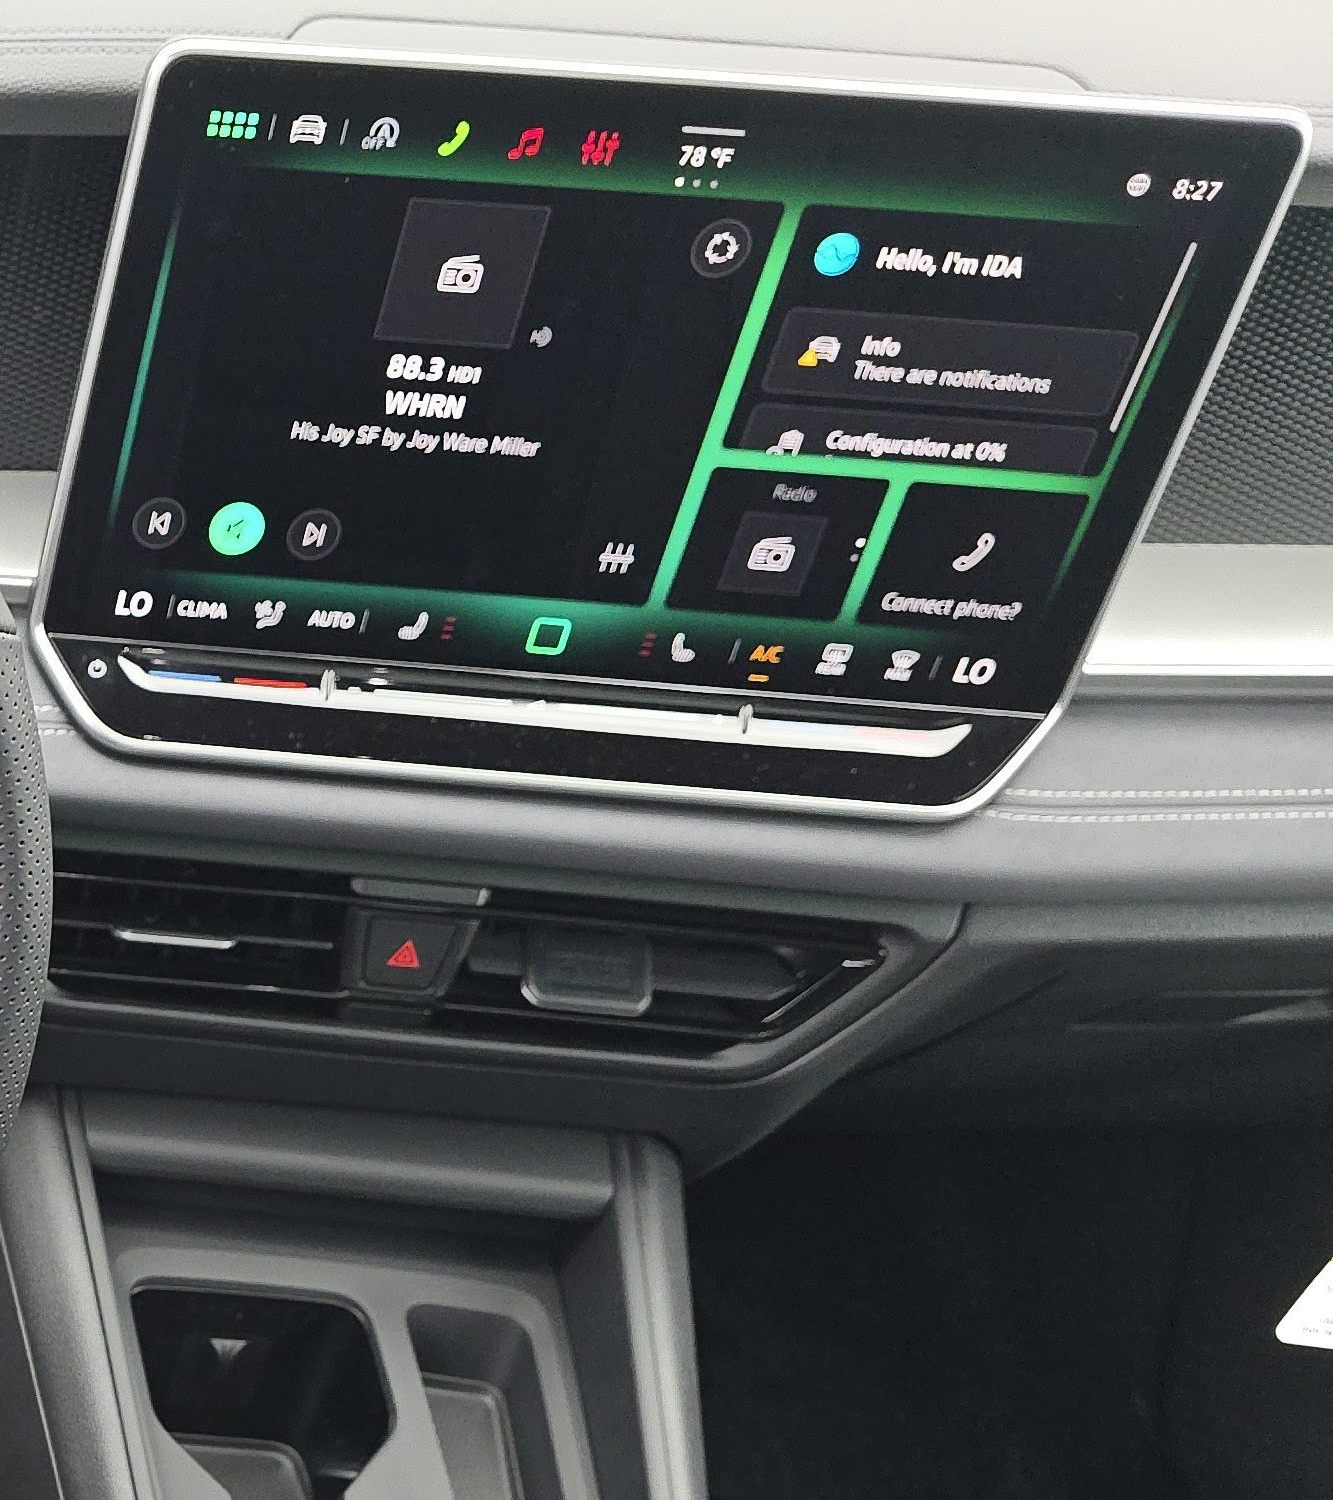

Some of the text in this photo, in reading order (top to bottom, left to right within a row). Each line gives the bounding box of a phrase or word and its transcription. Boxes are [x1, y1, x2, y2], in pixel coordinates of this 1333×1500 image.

[678, 145, 707, 167] 78
[1172, 179, 1224, 202] 8:27
[876, 247, 1023, 280] Hello, I'm IDA
[861, 335, 901, 357] Info
[386, 353, 482, 384] 88.3 HD1
[854, 360, 1052, 394] There are notifications
[385, 389, 466, 420] WHRN
[290, 421, 541, 458] His Joy SF by Joy Ware Miller
[825, 429, 1008, 463] Configuration at 0%
[772, 484, 817, 502] Radio
[114, 589, 154, 618] LO
[176, 599, 228, 620] CLIMA
[881, 592, 1023, 621] Connect phone?
[307, 609, 356, 630] AUTO
[749, 644, 784, 664] A/C
[951, 656, 997, 686] LO
